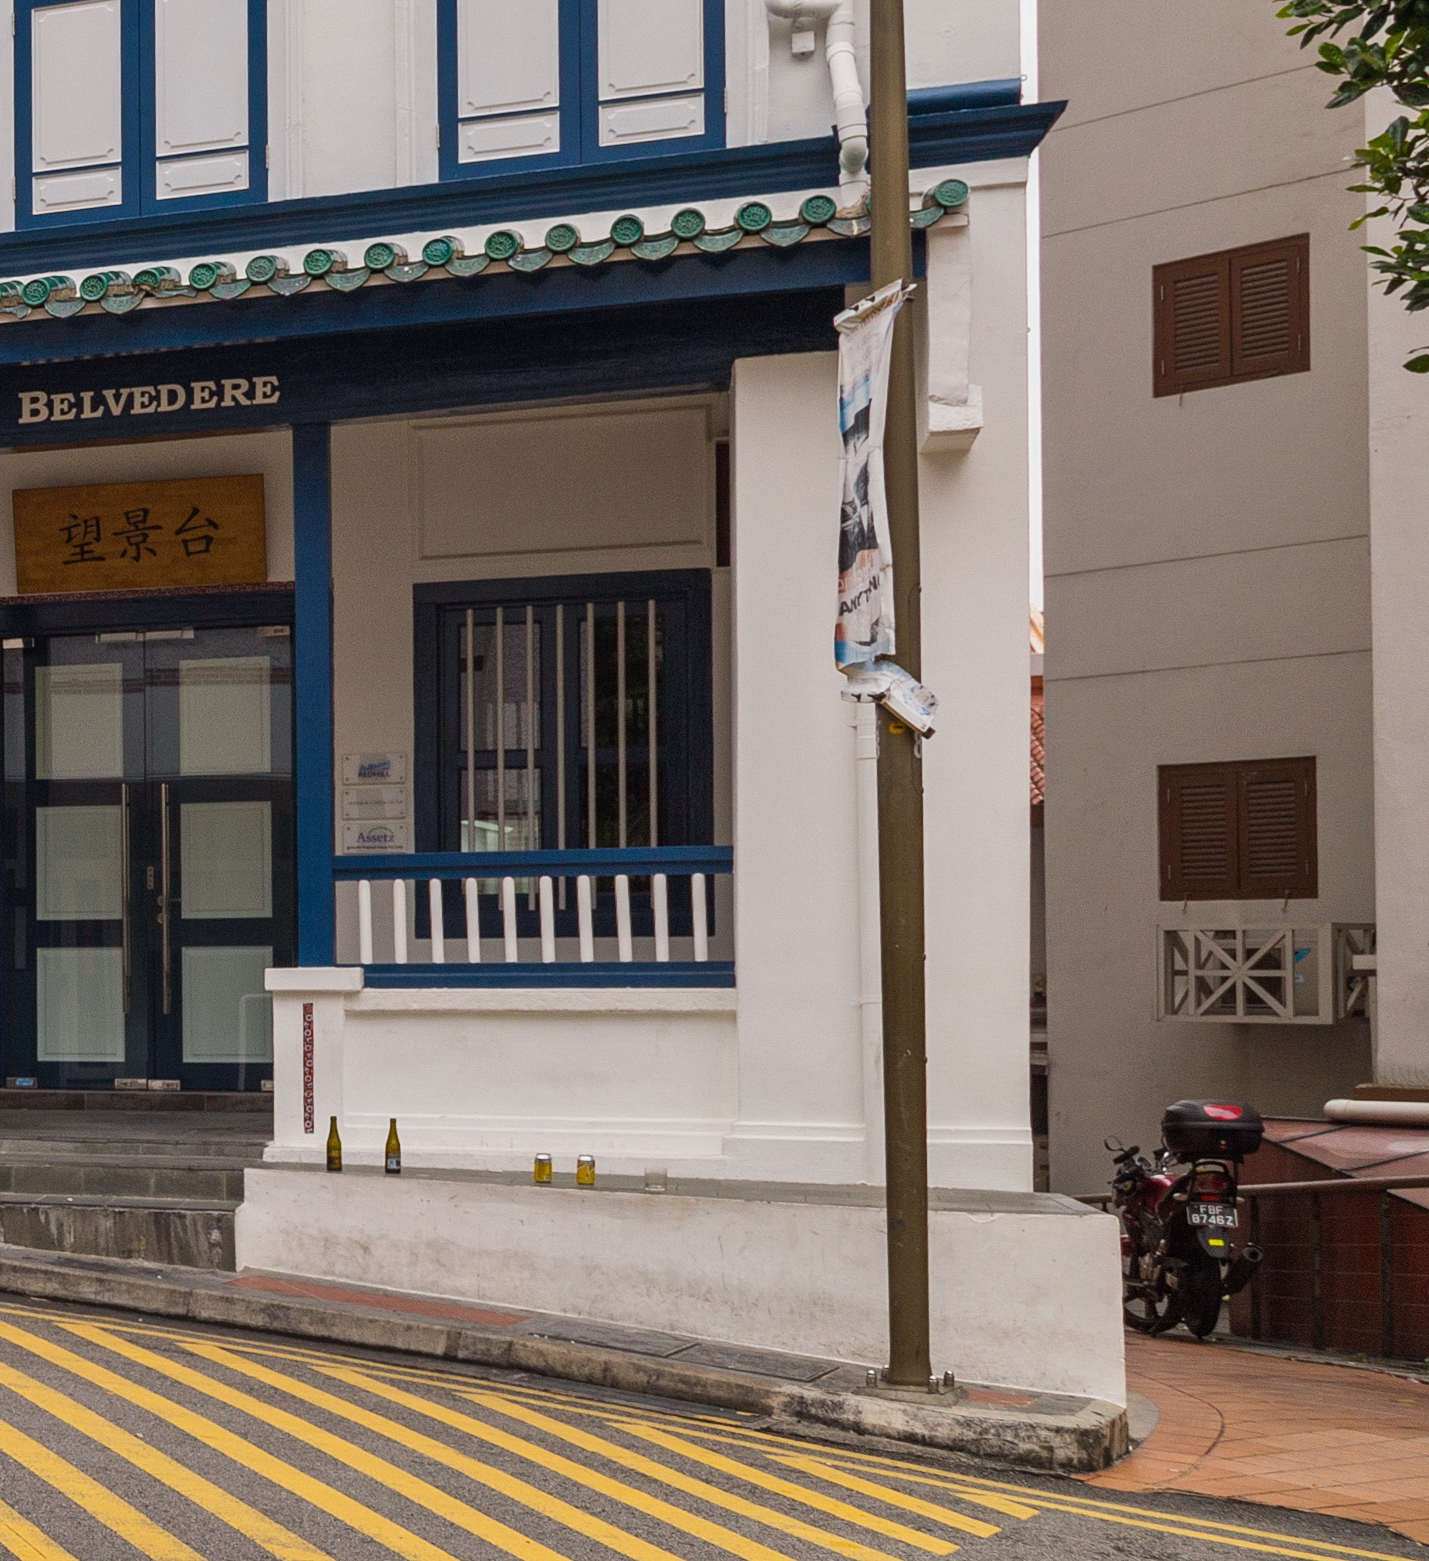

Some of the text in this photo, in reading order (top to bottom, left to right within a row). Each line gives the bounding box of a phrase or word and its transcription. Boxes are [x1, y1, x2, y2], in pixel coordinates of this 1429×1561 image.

[18, 376, 281, 424] BELVEDERE
[58, 507, 220, 566] 望景台
[357, 832, 394, 843] Assetz
